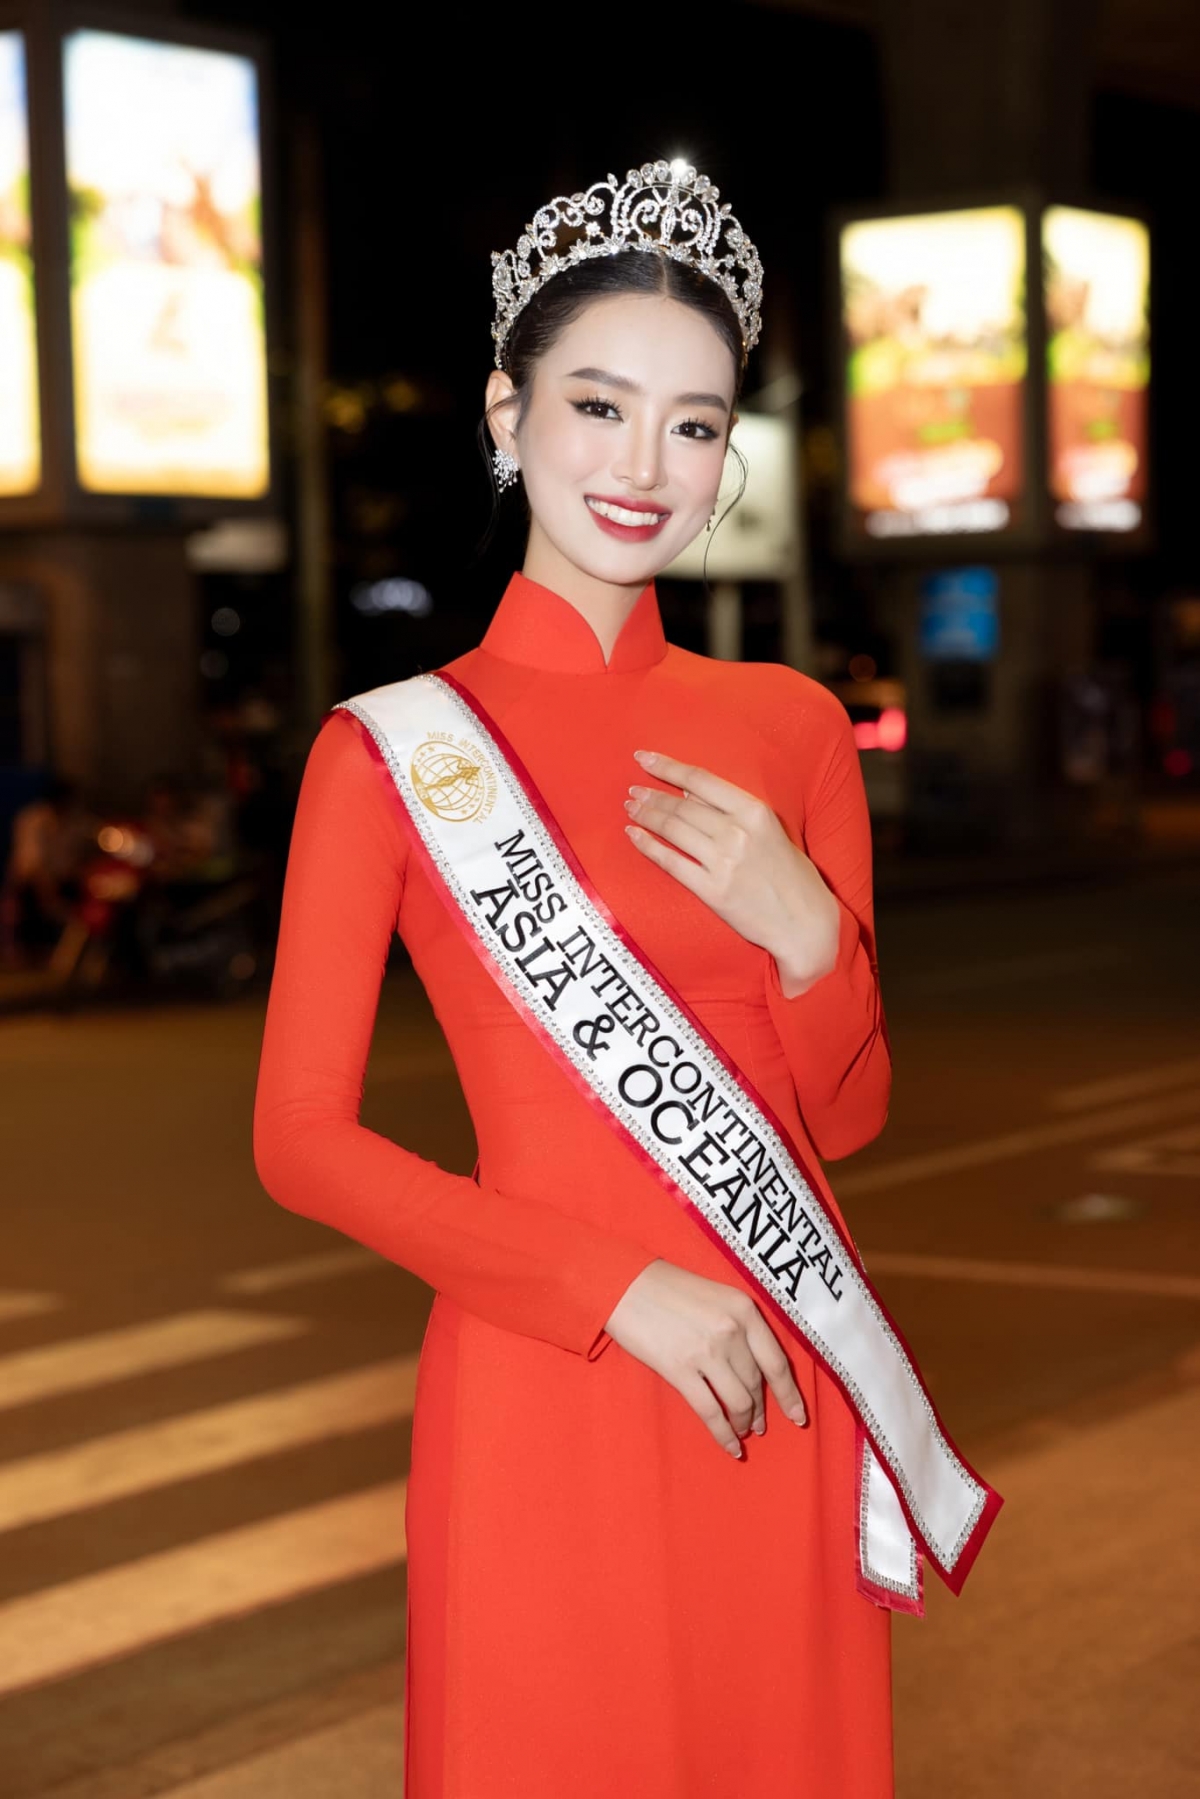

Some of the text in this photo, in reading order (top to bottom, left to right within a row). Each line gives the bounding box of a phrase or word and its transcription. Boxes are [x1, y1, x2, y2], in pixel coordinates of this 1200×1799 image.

[427, 731, 497, 824] MISS INTERCONTINENTAL
[470, 879, 809, 1302] ASIA & OCEANIA
[494, 829, 843, 1302] MISS INTERCONTINENTAL
